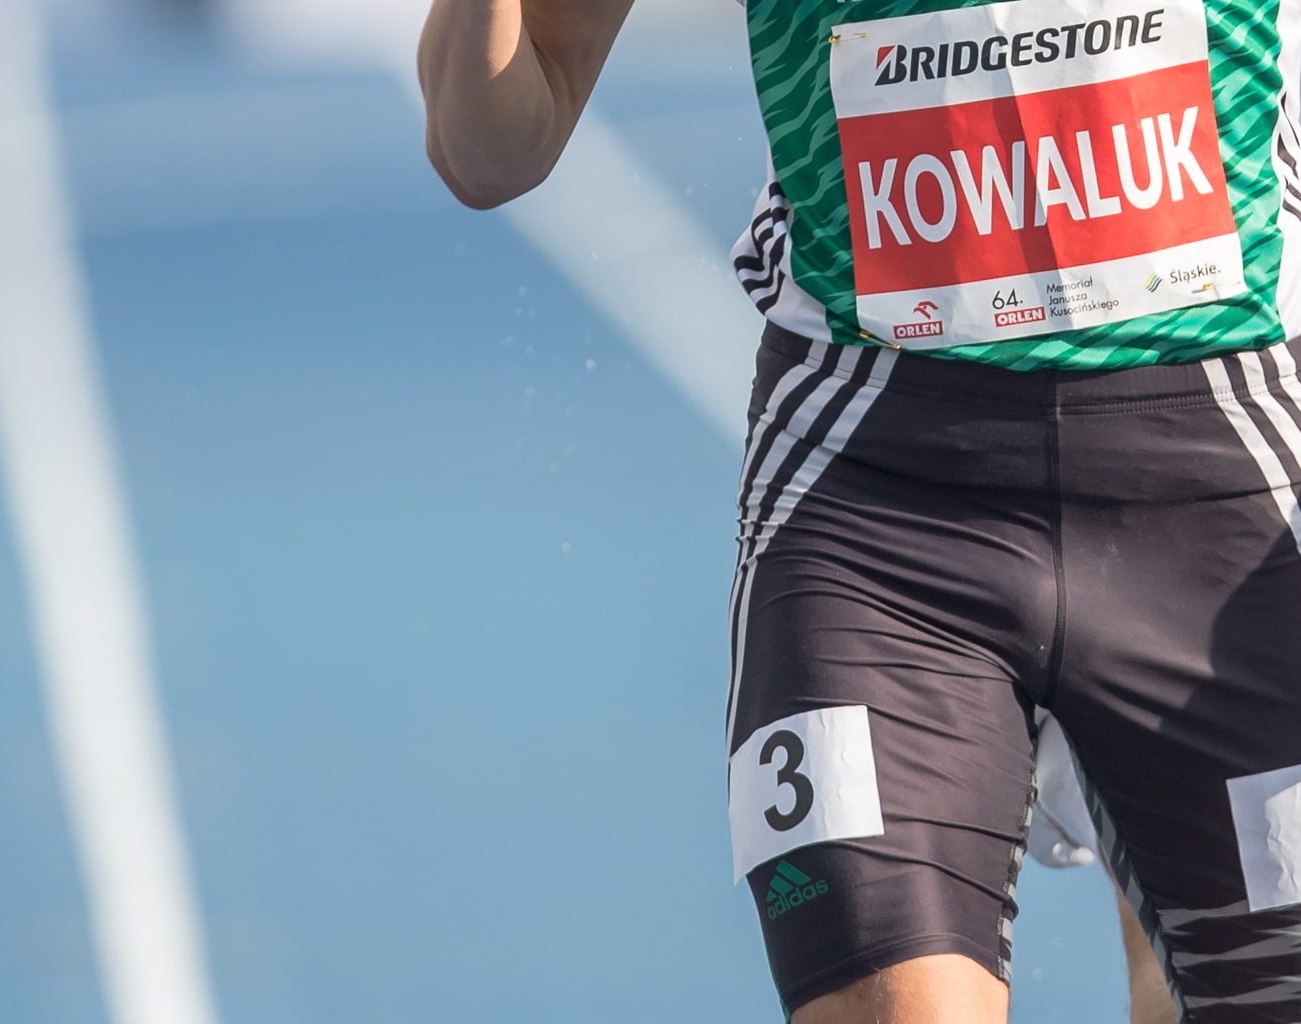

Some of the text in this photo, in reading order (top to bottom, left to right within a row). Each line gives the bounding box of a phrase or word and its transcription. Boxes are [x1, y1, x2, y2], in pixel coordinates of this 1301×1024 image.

[874, 8, 1165, 86] BRIDGESTONE
[858, 106, 1214, 250] KOWALUK
[1046, 275, 1094, 294] Memoriał
[991, 287, 1023, 310] 64.
[1048, 292, 1088, 306] Janusza
[1050, 298, 1120, 317] Kusocińskiego
[997, 308, 1044, 325] ORLEN
[896, 322, 940, 337] ORLEN
[759, 729, 814, 832] 3
[767, 879, 829, 920] adidas
